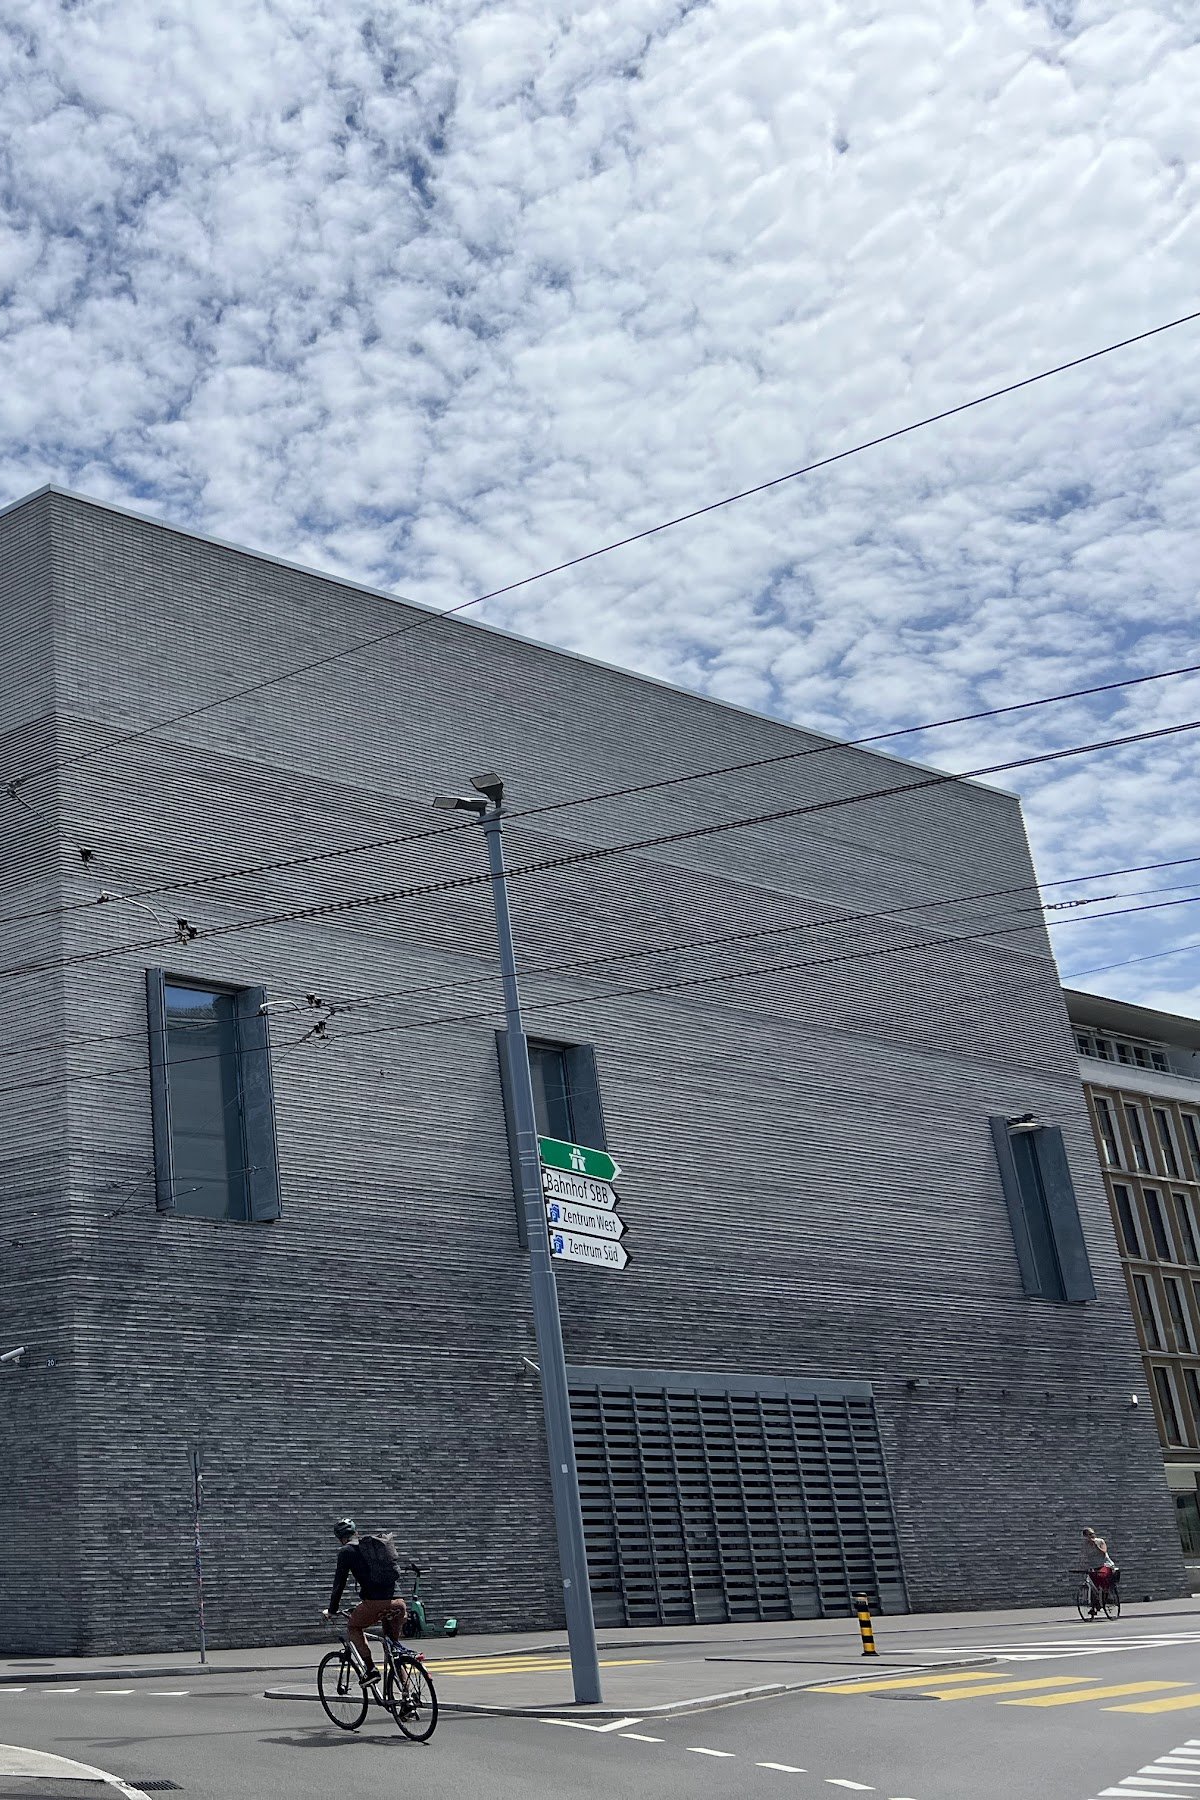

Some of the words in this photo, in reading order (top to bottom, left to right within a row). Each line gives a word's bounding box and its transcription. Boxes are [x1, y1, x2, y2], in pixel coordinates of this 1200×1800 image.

[547, 1174, 588, 1199] Bahnhof
[590, 1184, 609, 1204] SBB
[562, 1207, 596, 1228] Zentrum
[596, 1215, 617, 1233] West
[569, 1239, 602, 1259] Zentrum
[603, 1245, 619, 1262] Süd
